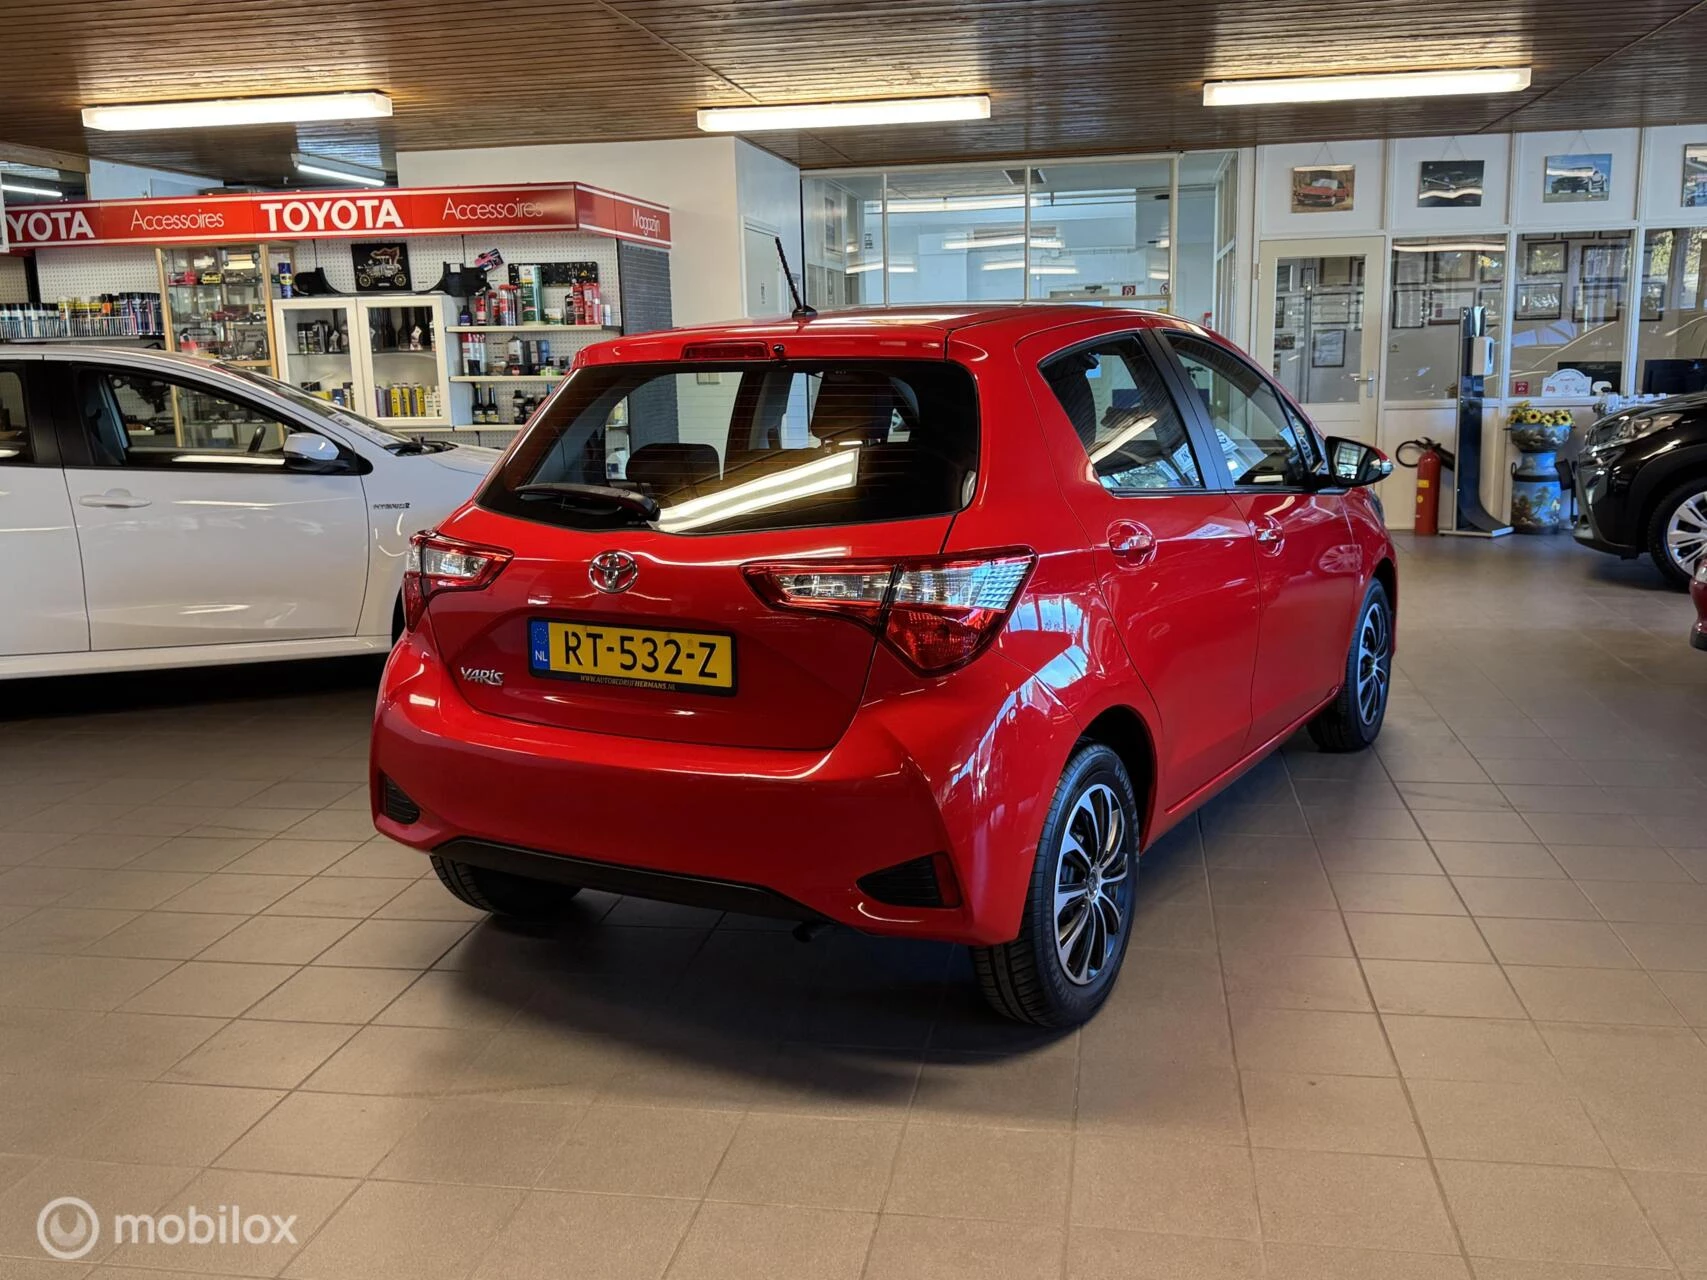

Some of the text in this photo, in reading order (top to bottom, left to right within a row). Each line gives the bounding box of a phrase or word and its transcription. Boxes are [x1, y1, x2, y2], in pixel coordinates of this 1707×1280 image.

[130, 208, 225, 232] Accessoires
[259, 198, 404, 232] TOYOTA
[442, 197, 544, 221] Accessoires
[632, 207, 661, 238] Magazijn
[535, 650, 548, 663] NL
[563, 630, 718, 679] RT-532-Z
